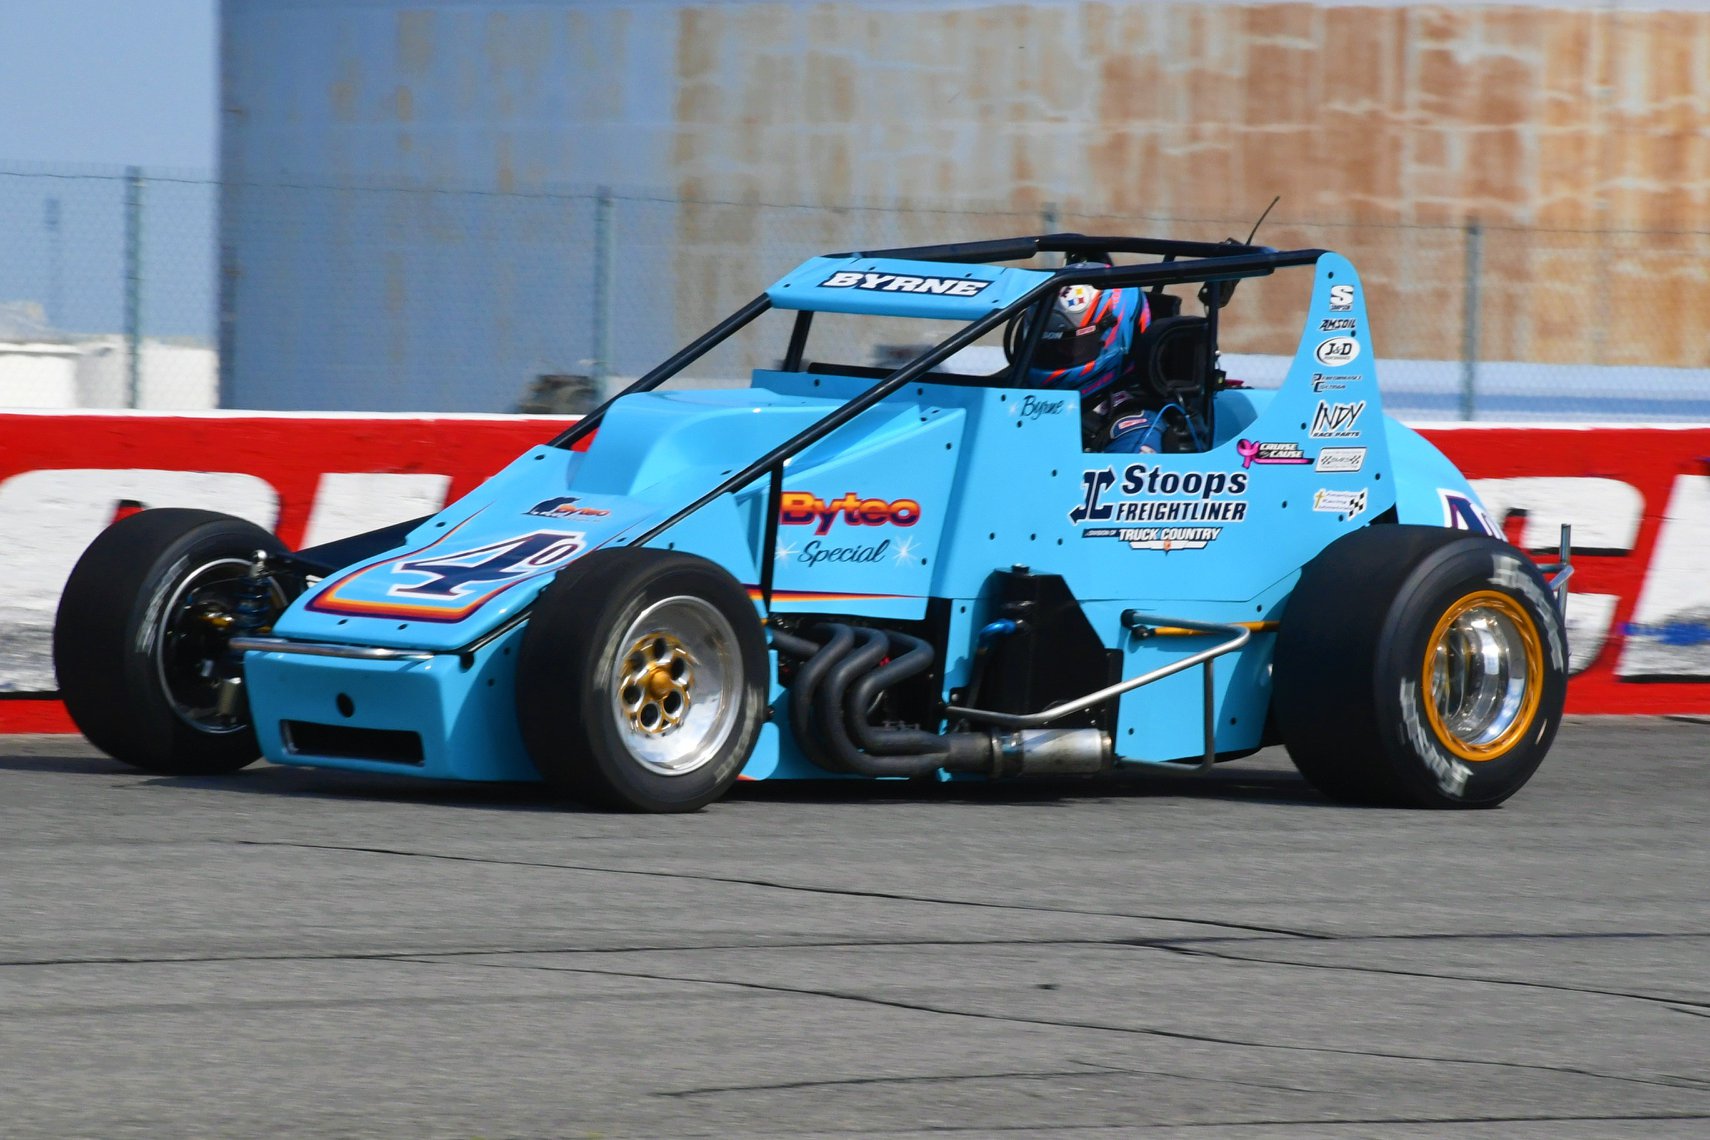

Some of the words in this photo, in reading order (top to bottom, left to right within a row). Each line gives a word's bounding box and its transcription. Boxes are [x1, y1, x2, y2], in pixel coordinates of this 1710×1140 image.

[822, 272, 988, 297] BYRNE
[1331, 286, 1353, 305] S
[1319, 319, 1356, 331] AMSOIL
[1325, 343, 1352, 355] J&D
[1020, 395, 1064, 420] Byrne
[1311, 402, 1363, 435] INDY
[1122, 464, 1247, 499] Stoops
[1116, 503, 1247, 520] FREIGHTLINER
[1119, 529, 1159, 540] TRUCK
[1161, 528, 1221, 540] COUNTRY
[798, 539, 891, 568] Special
